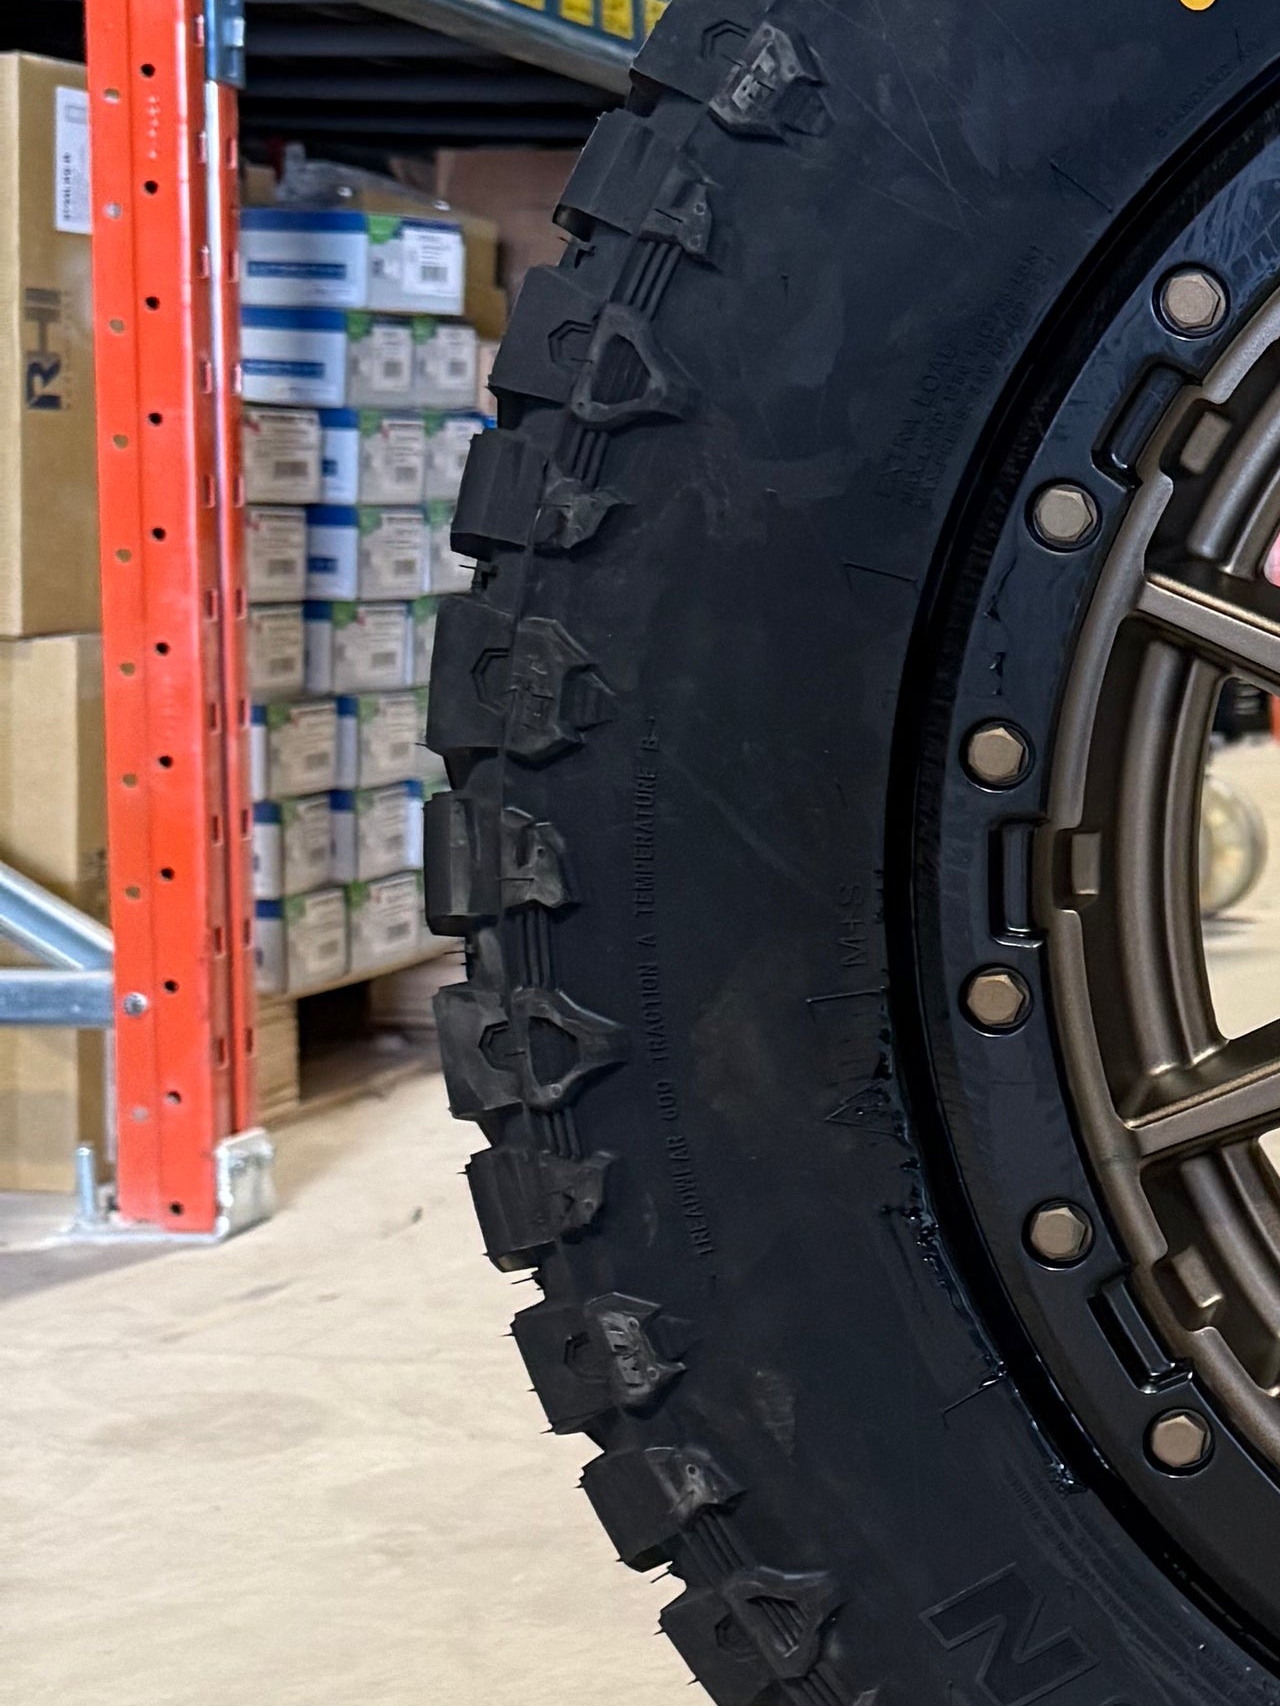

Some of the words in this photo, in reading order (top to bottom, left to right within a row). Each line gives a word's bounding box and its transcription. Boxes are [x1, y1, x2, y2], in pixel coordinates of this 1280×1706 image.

[629, 765, 657, 922] TEMPERATURE
[838, 880, 869, 969] M+S
[633, 961, 667, 1065] TRACTION
